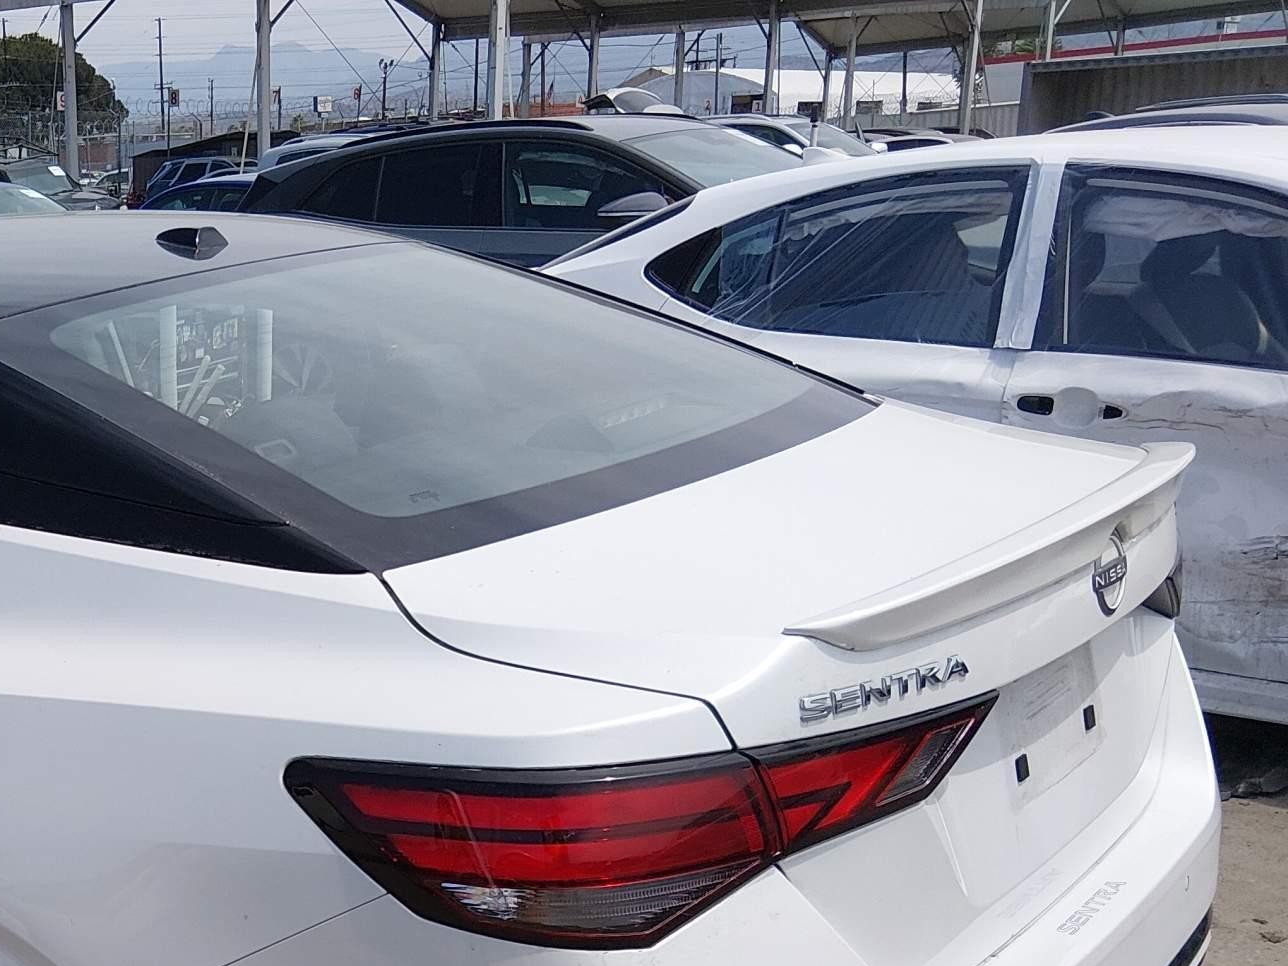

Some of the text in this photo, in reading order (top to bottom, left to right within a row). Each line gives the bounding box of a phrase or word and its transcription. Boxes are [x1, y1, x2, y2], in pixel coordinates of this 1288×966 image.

[170, 91, 177, 105] 8
[799, 654, 970, 721] SENTRA
[1056, 881, 1127, 935] SENTRA
